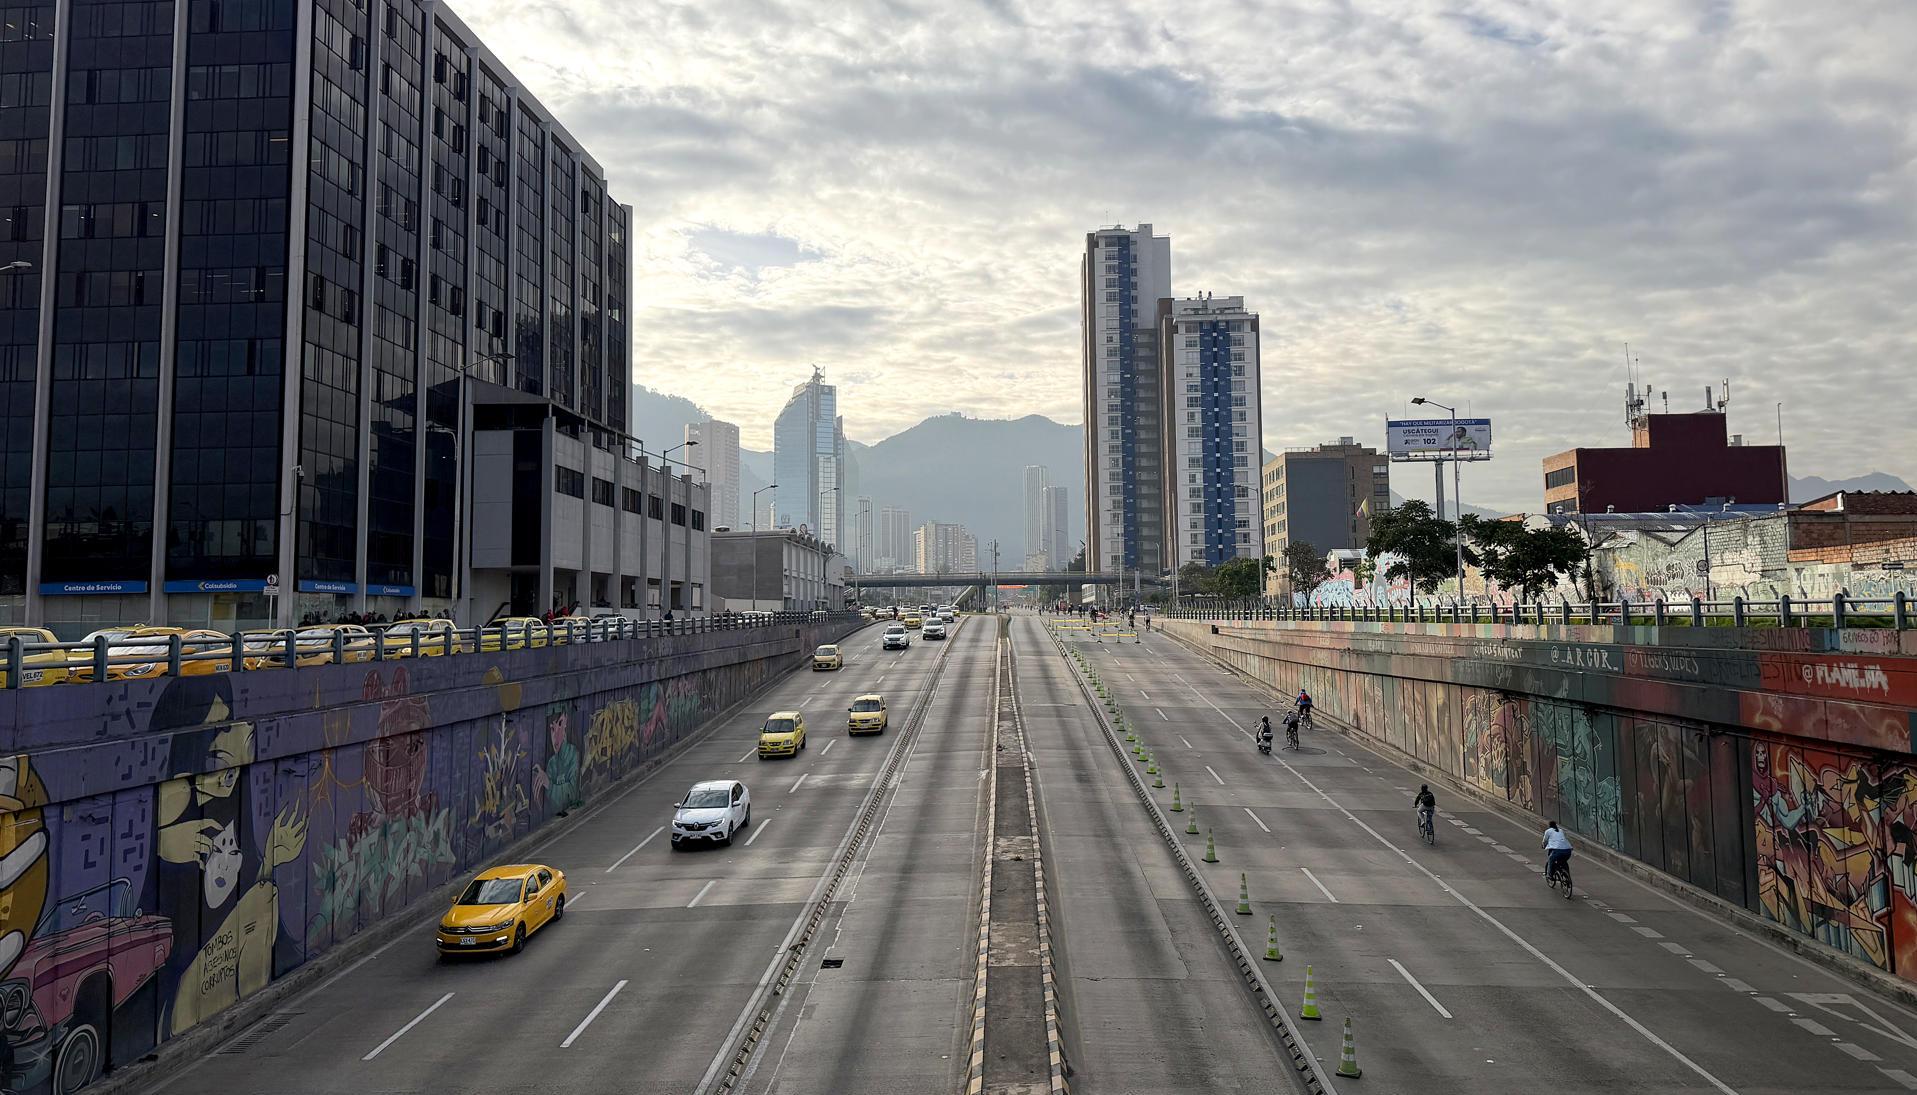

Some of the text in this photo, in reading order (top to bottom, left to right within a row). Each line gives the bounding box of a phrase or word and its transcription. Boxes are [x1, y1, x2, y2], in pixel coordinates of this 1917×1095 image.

[64, 583, 122, 592] Centro de Servicio
[204, 581, 237, 590] Colsubsidio
[1869, 631, 1880, 644] GO
[1882, 630, 1899, 645] HOME
[203, 931, 233, 958] TOMBOS
[204, 948, 237, 977] ASESINOS
[201, 965, 235, 995] CORRUPTOS
